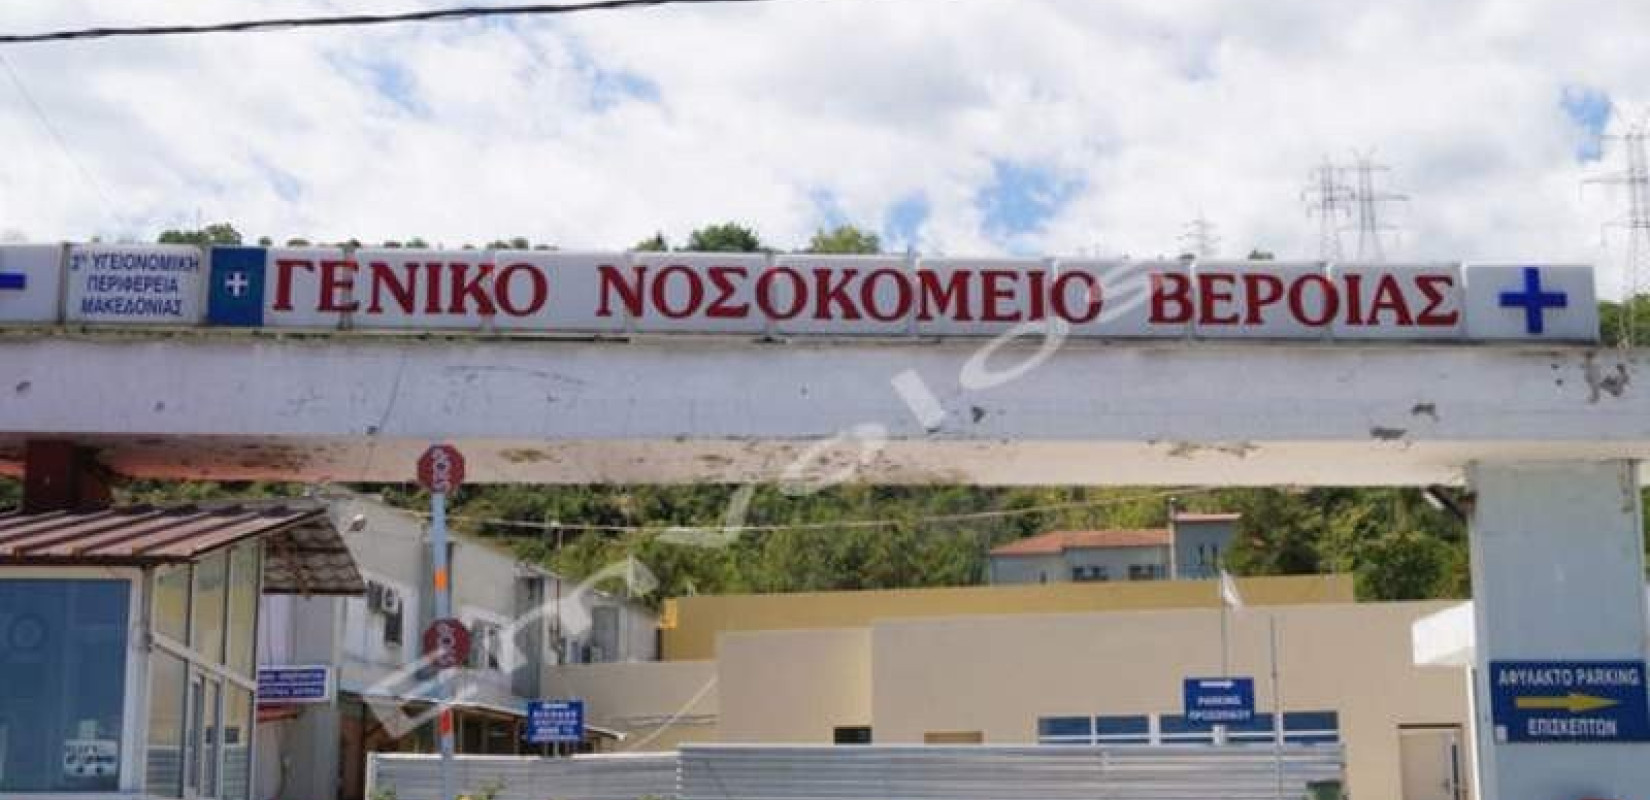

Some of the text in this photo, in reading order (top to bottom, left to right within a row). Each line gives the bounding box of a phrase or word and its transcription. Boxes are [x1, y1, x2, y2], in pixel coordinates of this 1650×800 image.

[87, 274, 178, 293] ΠΕΡΙΦΕΡΕΙΑ
[273, 259, 1459, 327] ΓΕΝΙΚΟ ΝΟΣΟΚΟΜΕΙΟ ΒΕΡΟΙΑΣ
[82, 296, 182, 316] ΜΑΚΕΔΟΝΙΑΣ
[1575, 668, 1640, 686] PARKING
